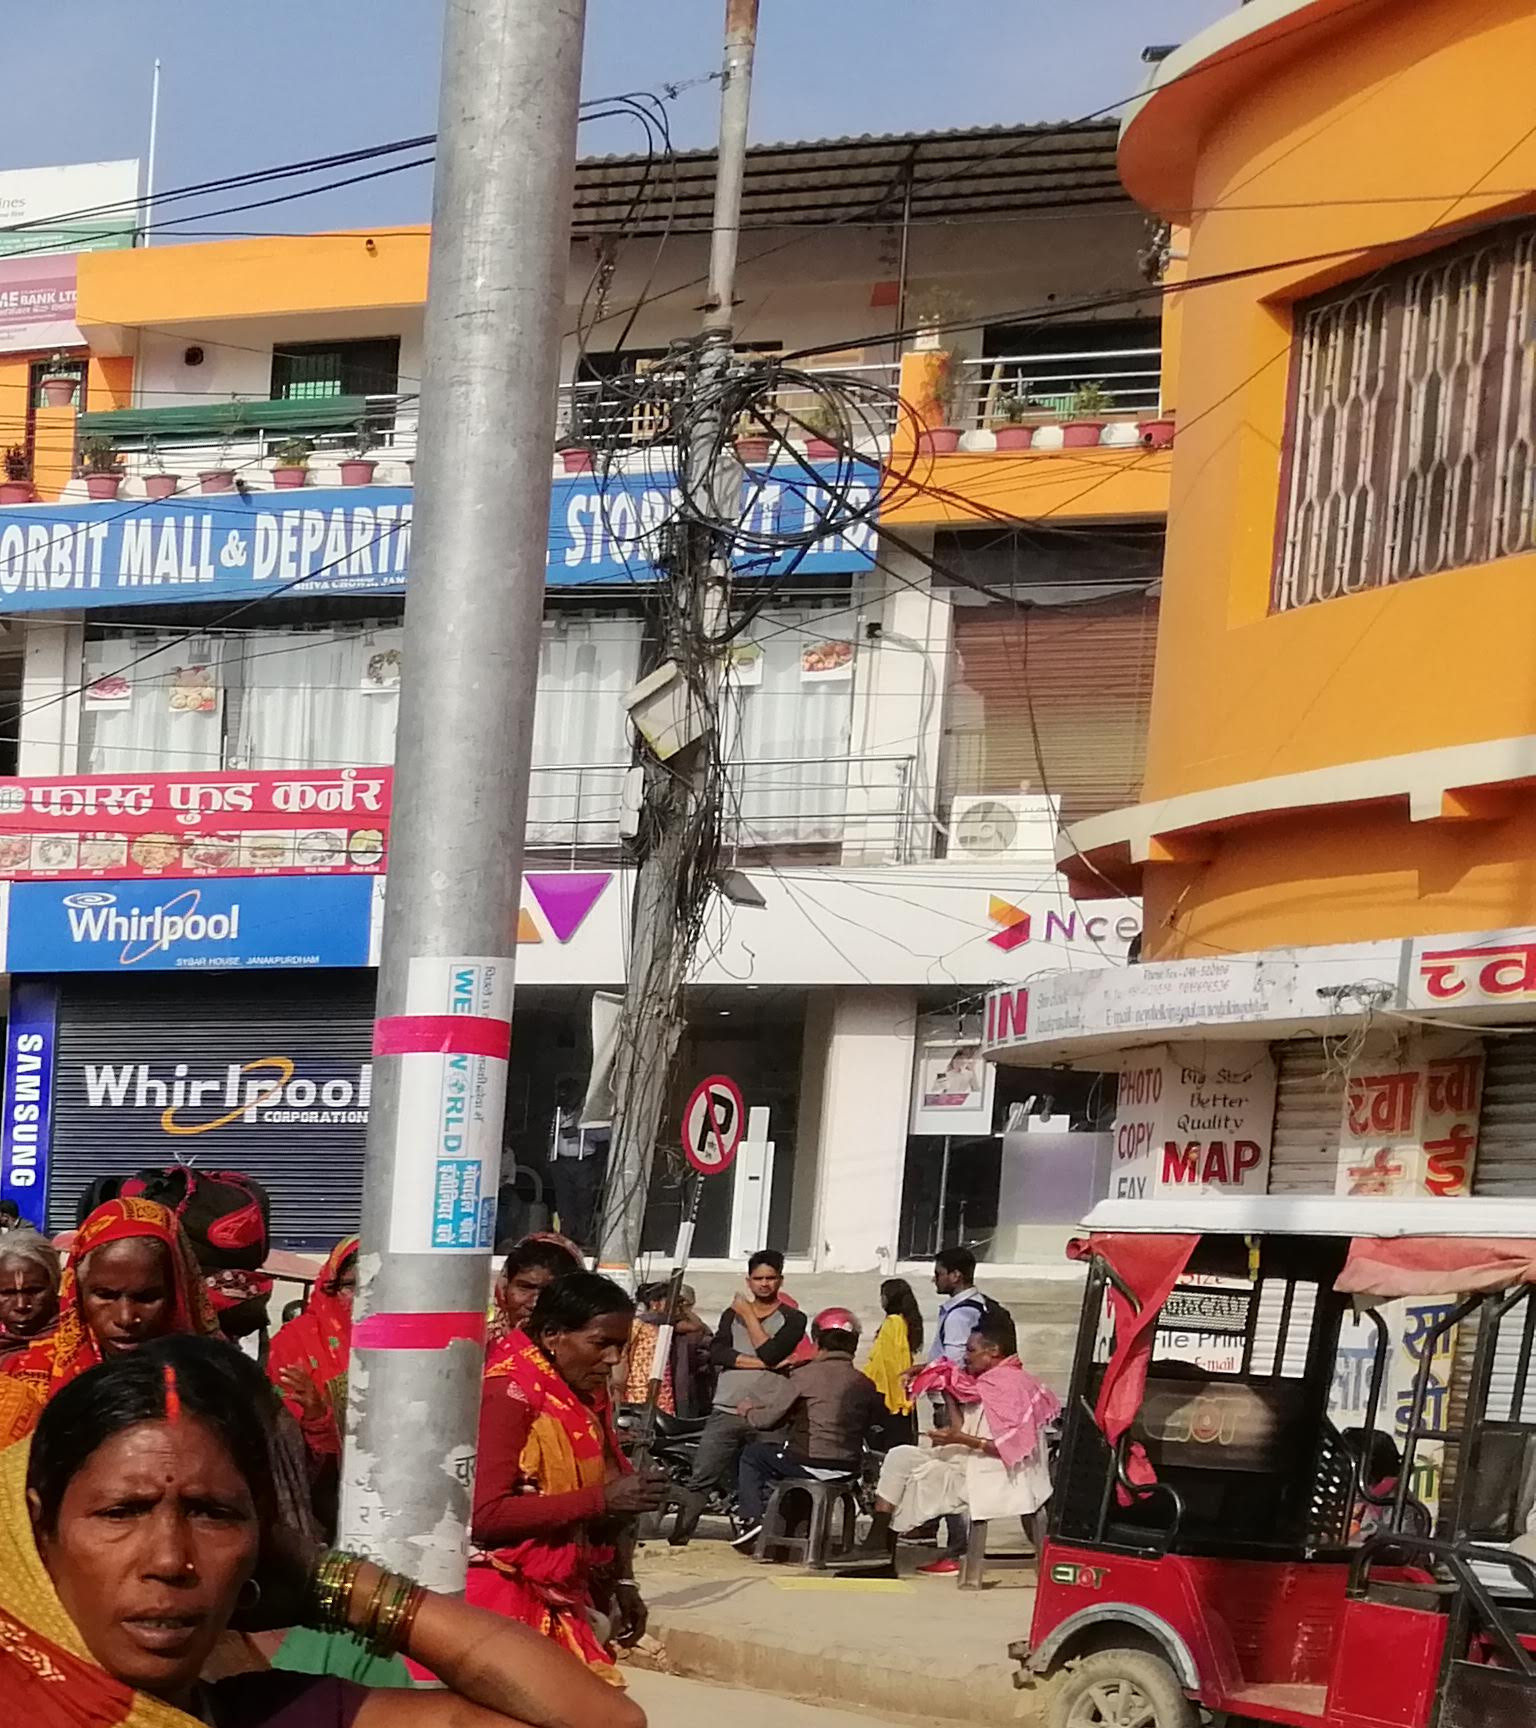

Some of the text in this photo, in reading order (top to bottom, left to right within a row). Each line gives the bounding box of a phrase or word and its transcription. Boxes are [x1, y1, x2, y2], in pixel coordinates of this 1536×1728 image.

[20, 292, 56, 306] BANK
[0, 521, 108, 594] ORBIT
[118, 513, 214, 587] MALL
[220, 531, 247, 568] &
[29, 768, 385, 825] फास्ट फुड कर्नर
[66, 903, 240, 951] Whirlpool
[1044, 910, 1139, 943] Nce
[83, 1062, 373, 1124] Whirlpool
[1118, 1067, 1162, 1107] PHOTO
[9, 1032, 44, 1188] SAMSUNG
[263, 1110, 370, 1124] CORPORATION
[1177, 1113, 1244, 1135] Quality
[1118, 1121, 1155, 1160] COPY
[1161, 1139, 1263, 1186] MAP
